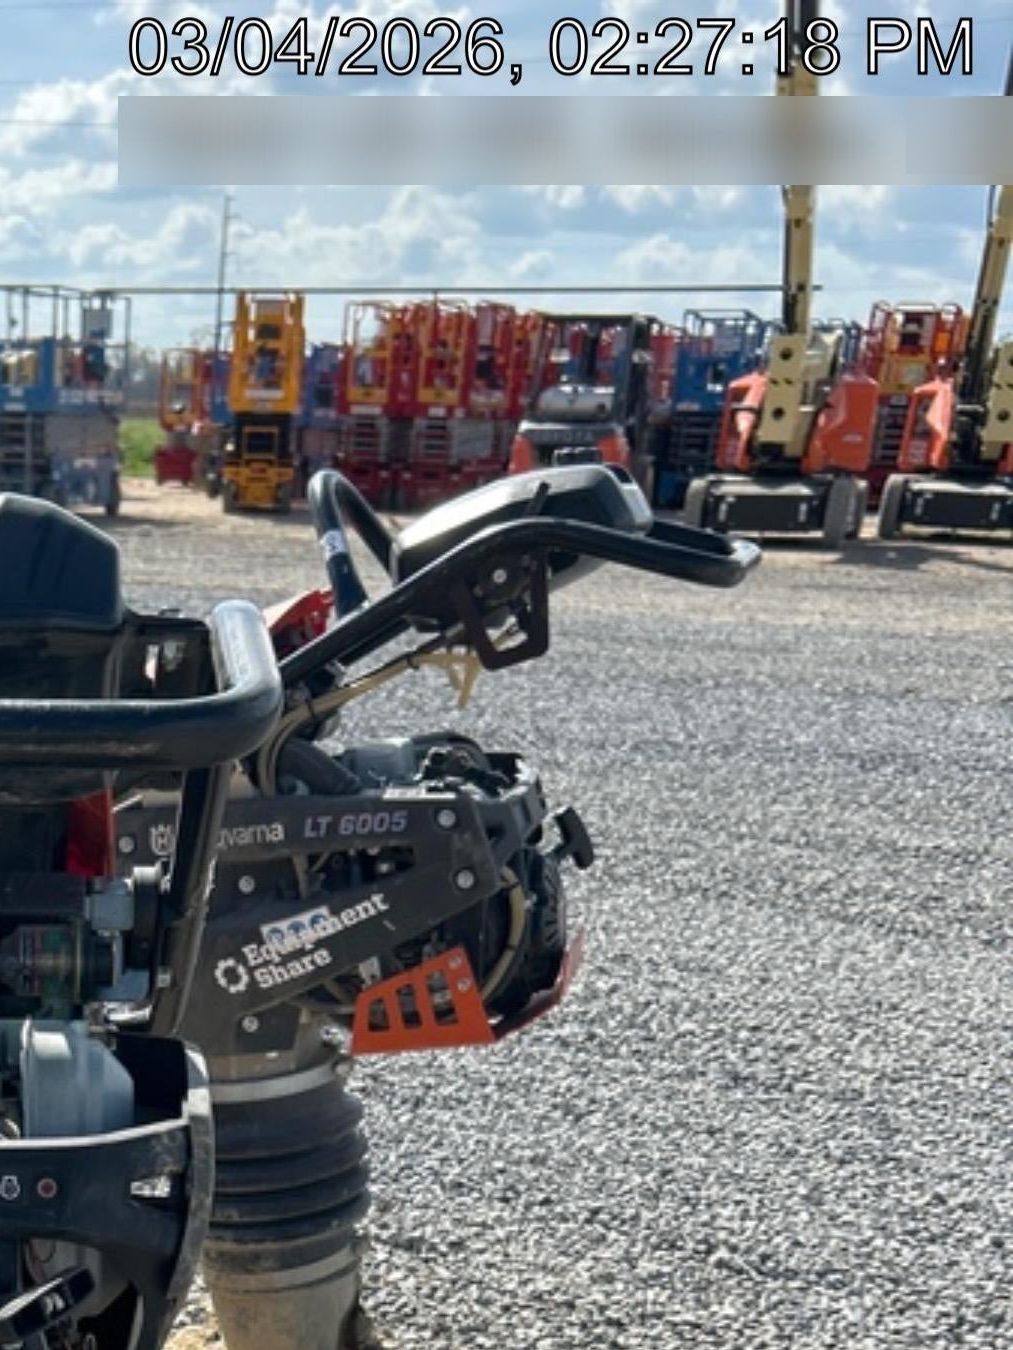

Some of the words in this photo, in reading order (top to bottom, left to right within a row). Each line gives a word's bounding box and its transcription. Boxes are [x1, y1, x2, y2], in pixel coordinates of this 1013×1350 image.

[531, 431, 595, 442] YOTA
[303, 815, 333, 838] LT
[338, 811, 408, 836] 6005
[253, 947, 333, 989] Share
